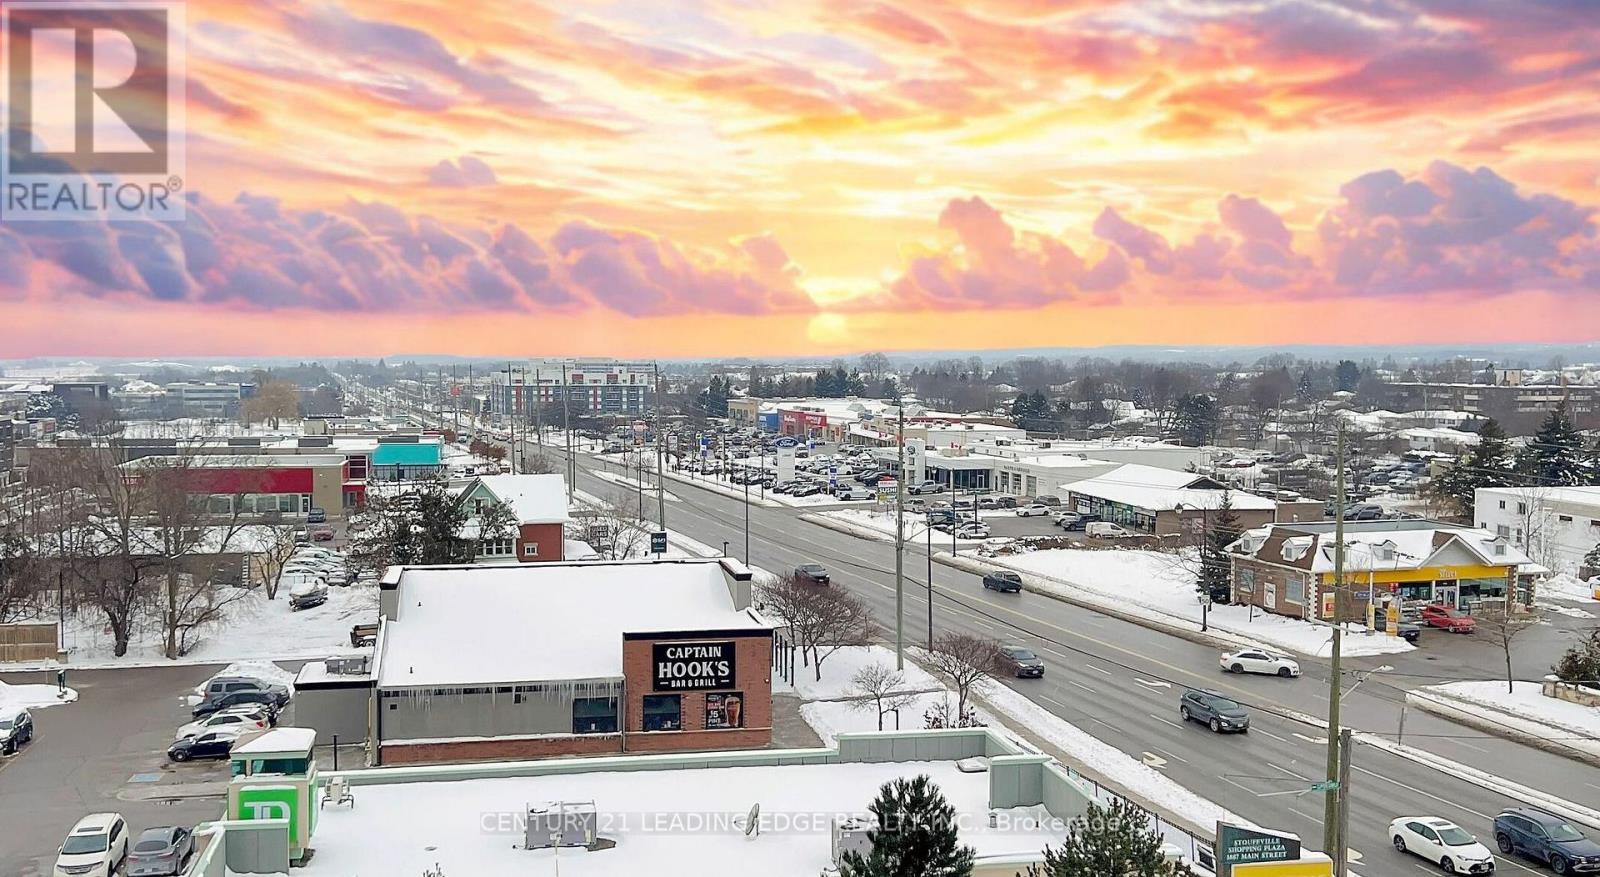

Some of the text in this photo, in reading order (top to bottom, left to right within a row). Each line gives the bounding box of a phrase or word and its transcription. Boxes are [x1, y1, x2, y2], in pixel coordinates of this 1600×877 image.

[666, 646, 722, 659] CAPTAIN
[658, 661, 730, 678] HOOK'S
[671, 679, 686, 688] BAR
[694, 678, 716, 687] GRILL
[1232, 838, 1280, 847] STOUFFVILLE
[1227, 845, 1262, 853] SHOPPING
[1241, 852, 1259, 860] MAIN
[1261, 851, 1287, 859] STREET
